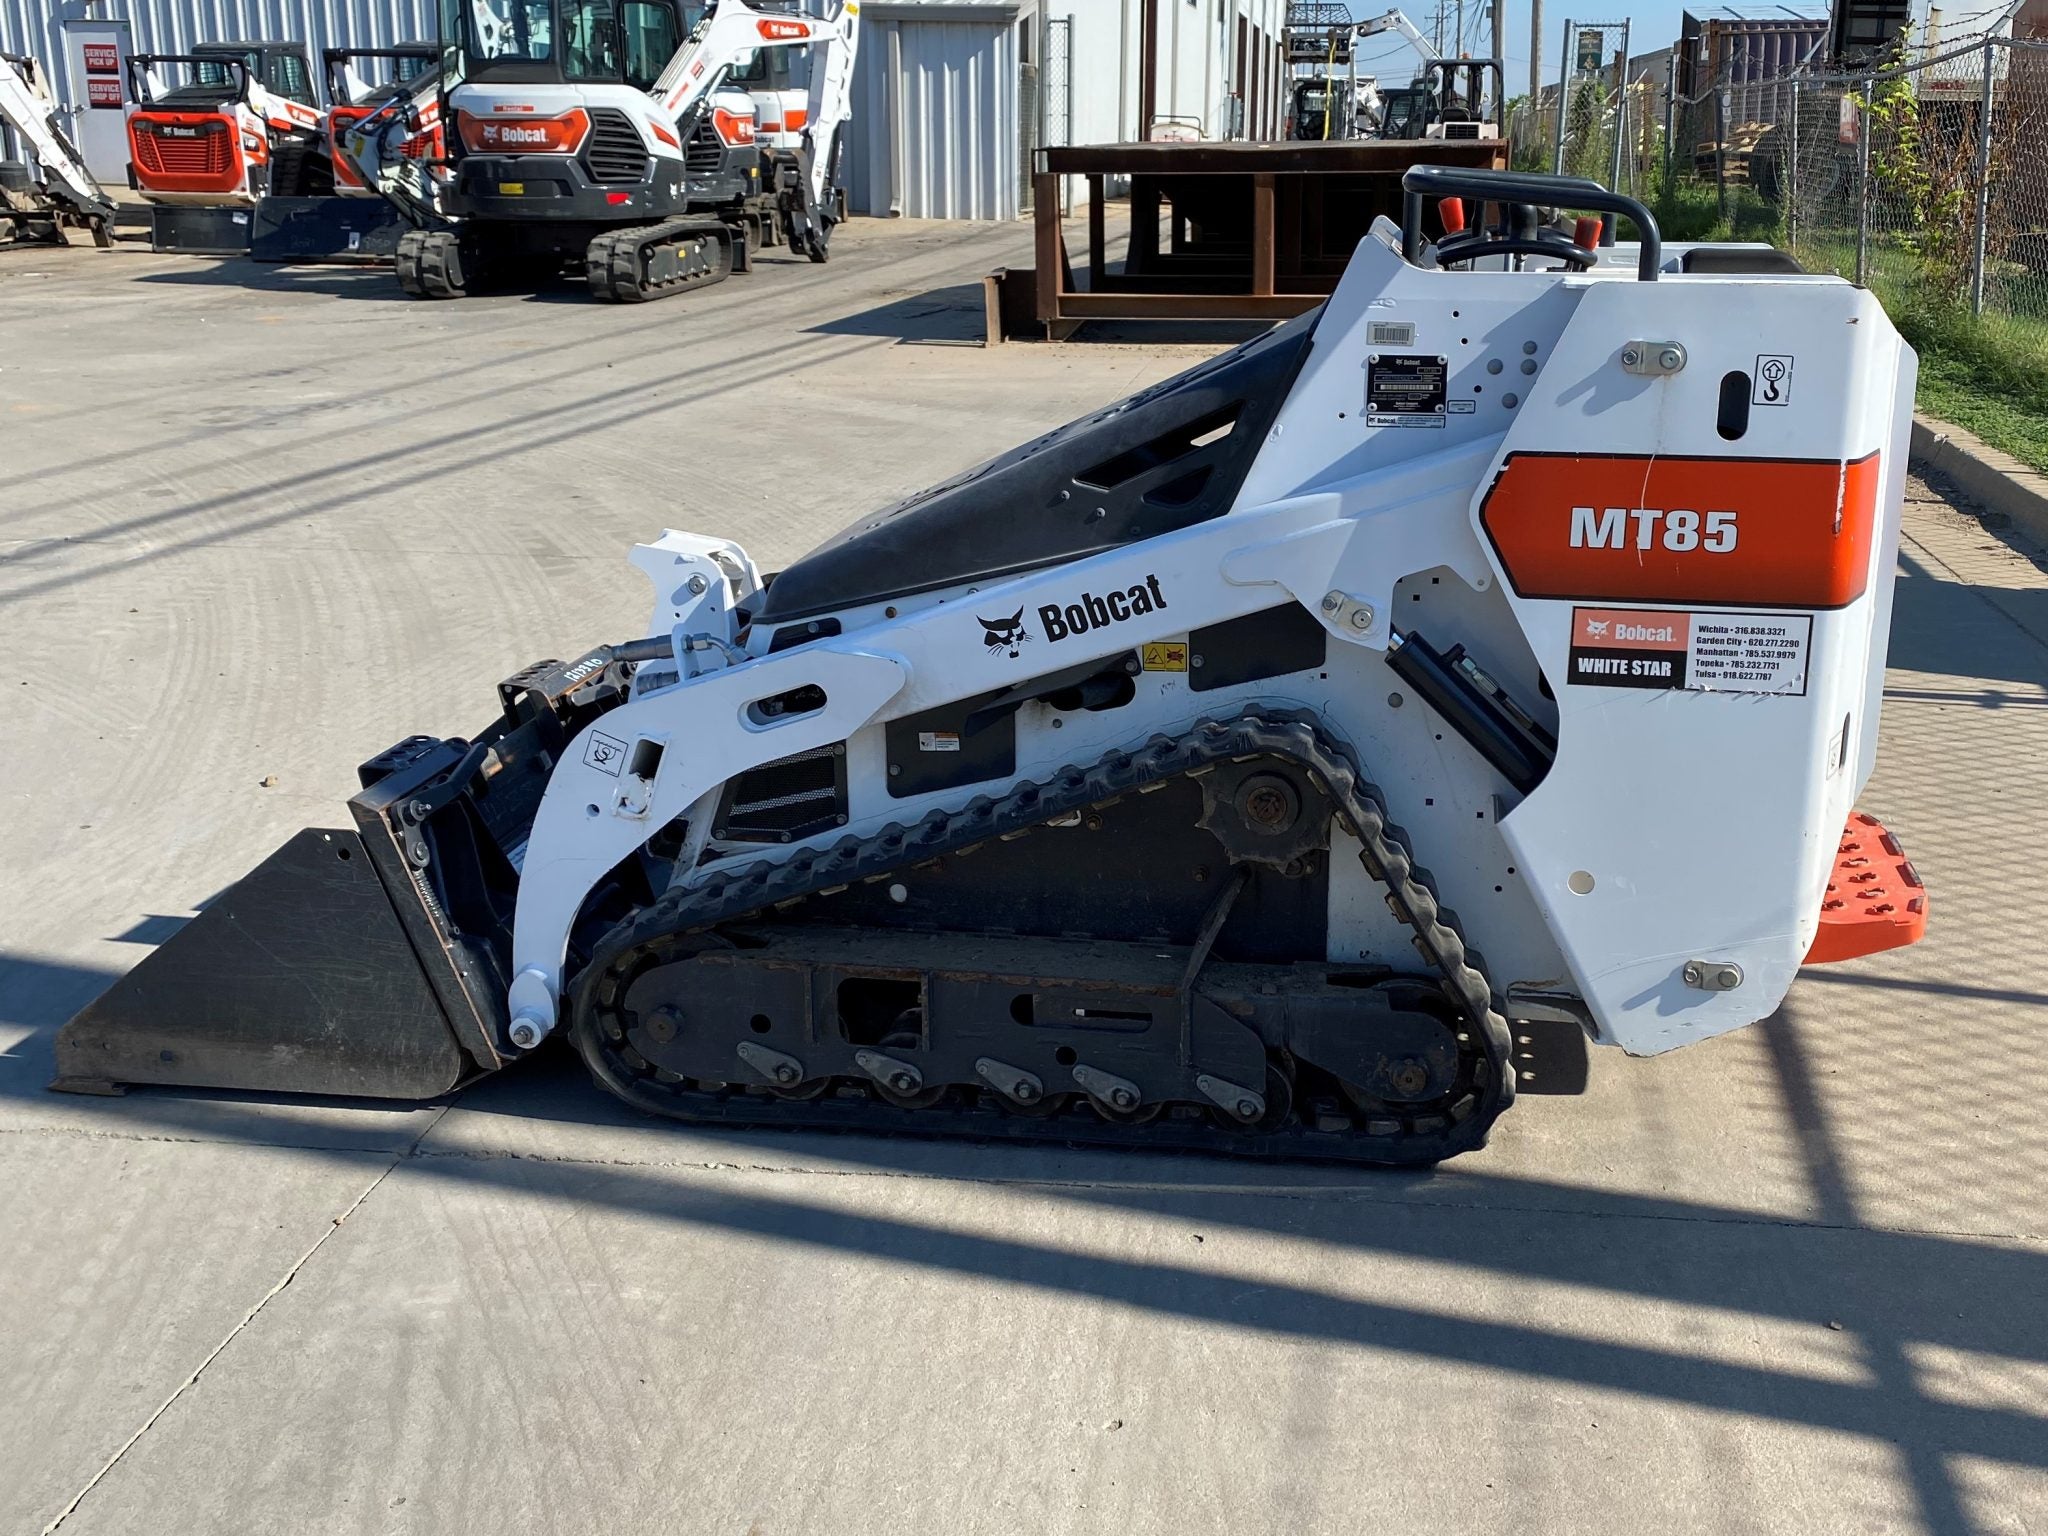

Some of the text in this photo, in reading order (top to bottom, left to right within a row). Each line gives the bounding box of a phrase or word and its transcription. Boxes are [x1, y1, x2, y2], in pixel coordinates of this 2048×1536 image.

[85, 49, 116, 57] SERVICE
[89, 84, 120, 92] SERVICE
[90, 92, 121, 101] DROP OFF
[501, 126, 546, 142] Bobcat
[1568, 506, 1739, 554] MT85
[1037, 573, 1167, 643] Bobcat
[1615, 623, 1673, 642] Bobcat
[1698, 625, 1786, 636] Wichita 316.838.3321
[1696, 636, 1800, 648] Garden City 620.277.2290
[1696, 647, 1739, 657] Manhattan
[1578, 657, 1672, 677] WHITE STAR
[1695, 659, 1780, 670] Topeka 785.232.7731
[1695, 670, 1716, 678] Tulsa
